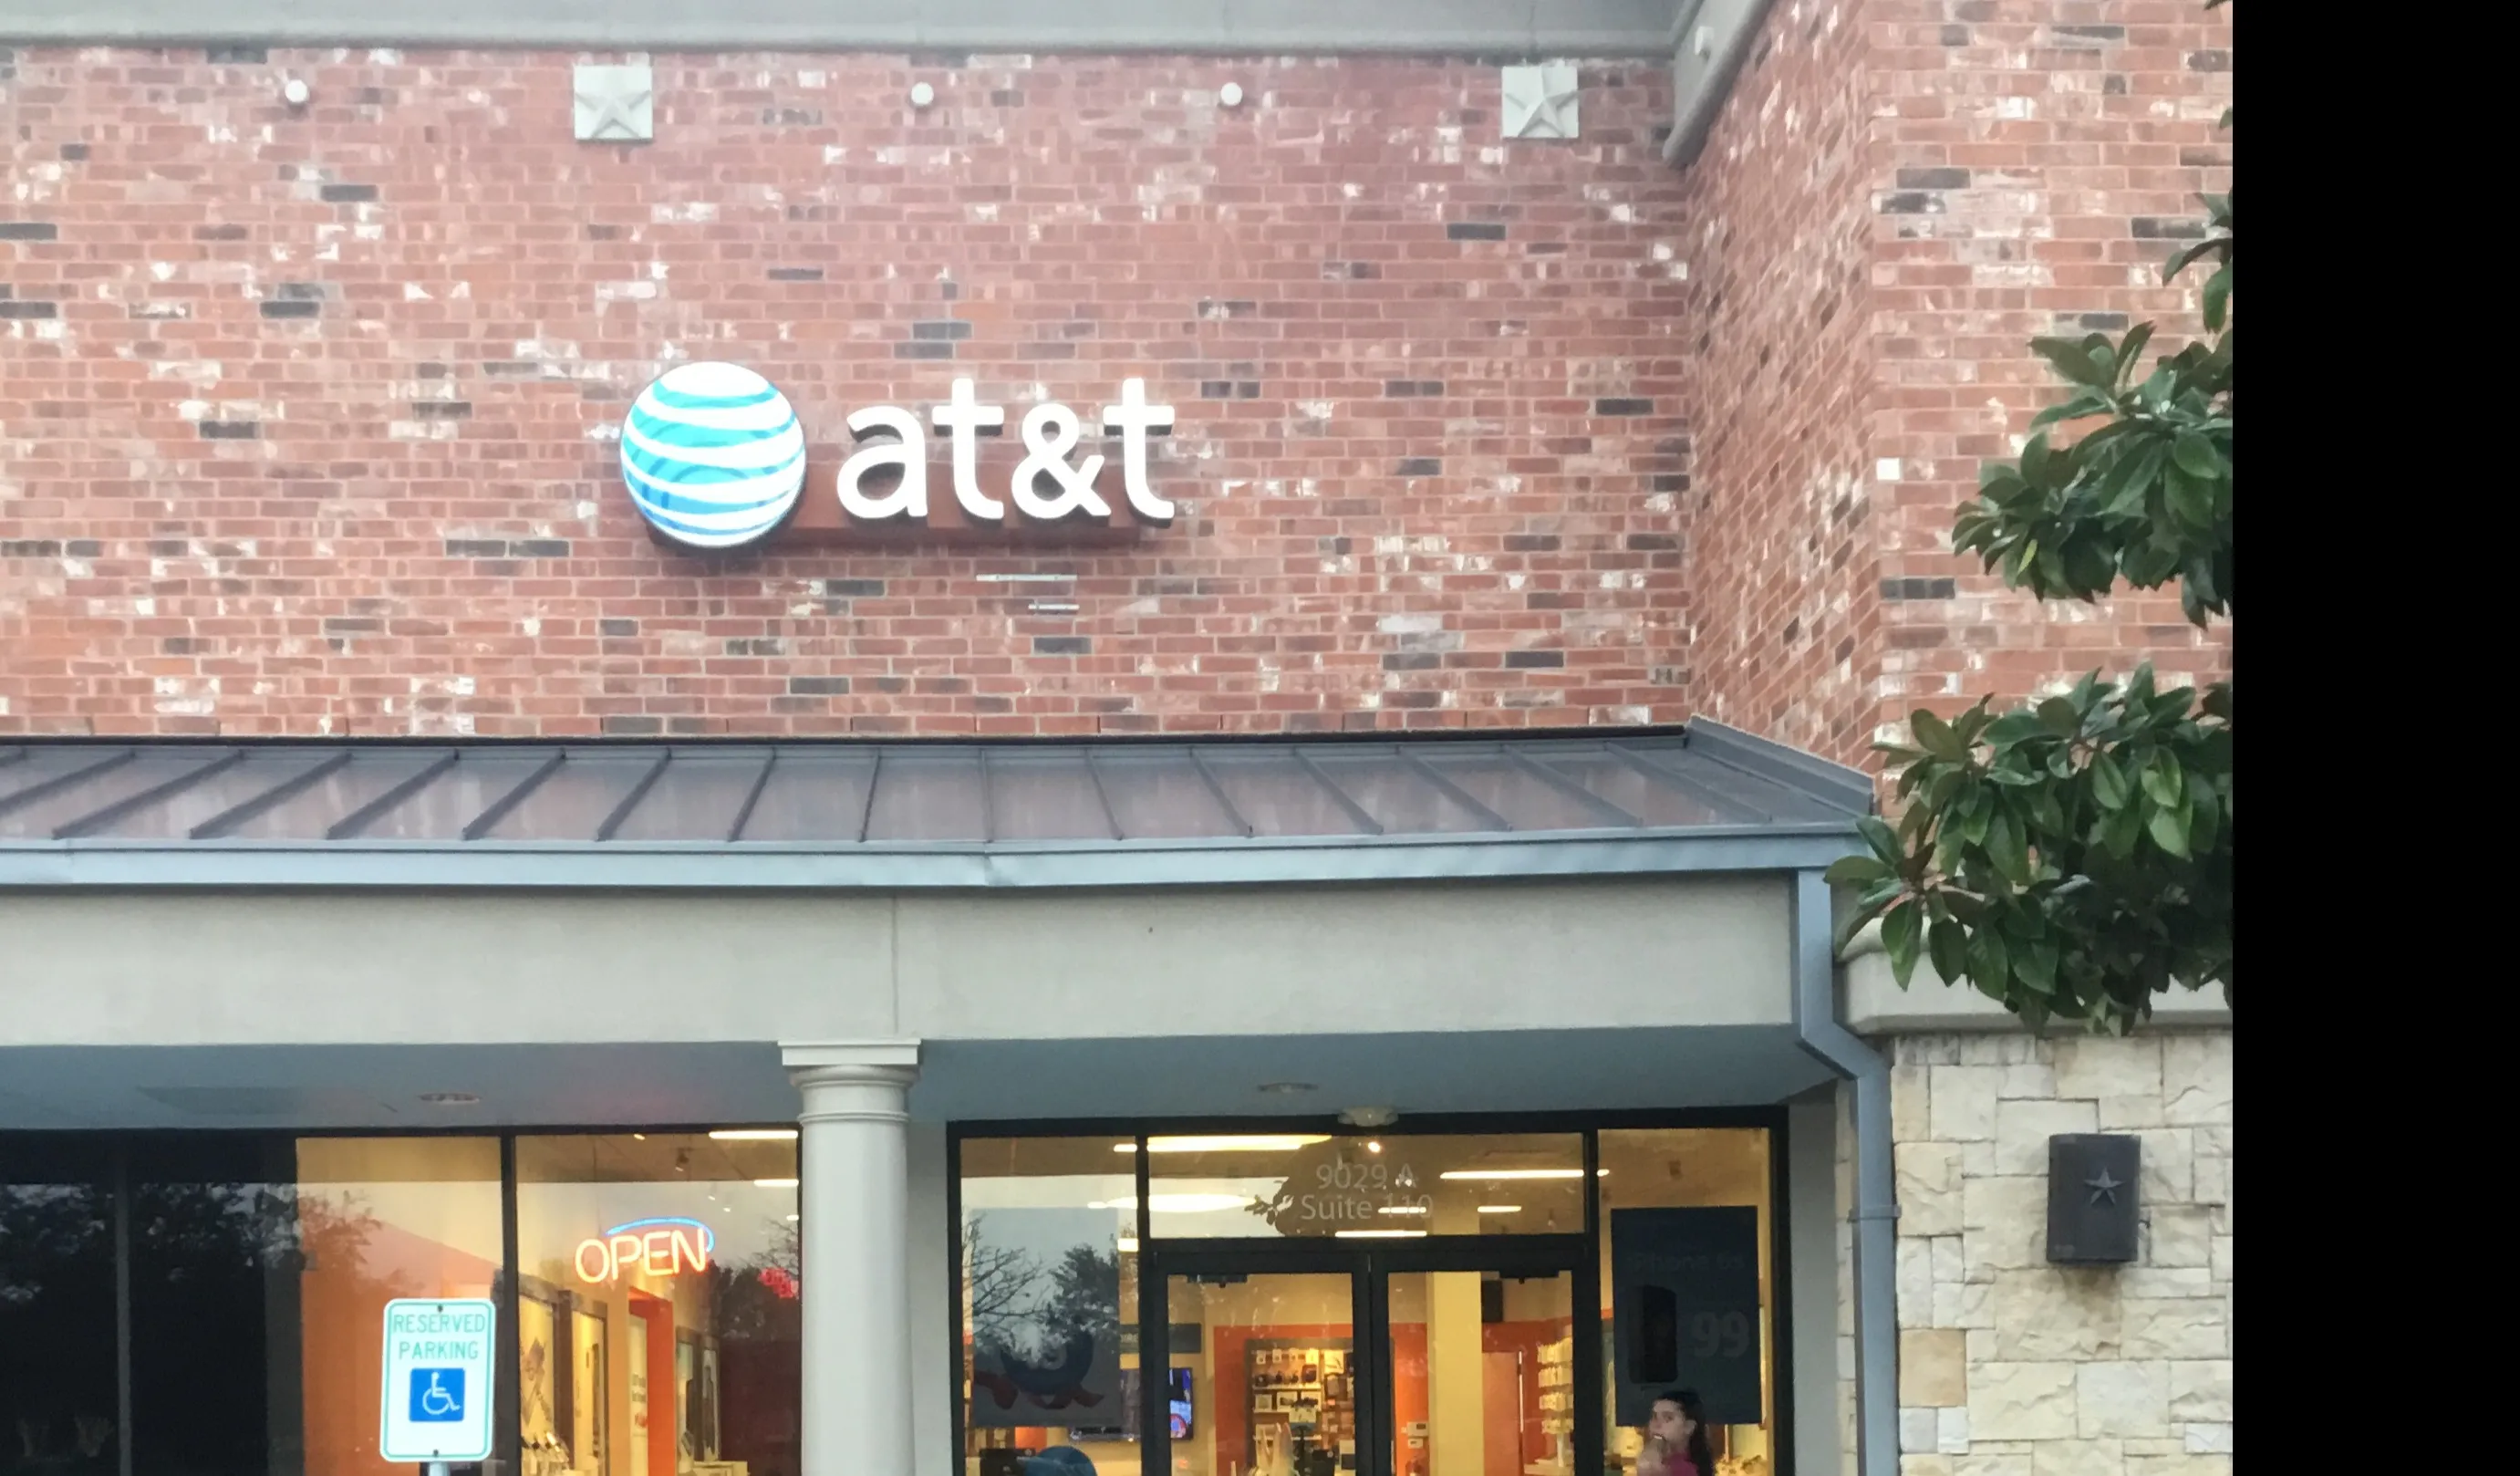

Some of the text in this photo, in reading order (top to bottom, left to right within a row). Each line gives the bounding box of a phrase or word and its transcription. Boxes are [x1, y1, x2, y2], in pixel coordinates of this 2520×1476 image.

[835, 377, 1177, 523] at&t
[1315, 1163, 1419, 1190] 9029 A
[1300, 1193, 1435, 1221] Suite 110
[575, 1228, 707, 1284] OPEN
[392, 1313, 486, 1334] RESERVED
[1691, 1310, 1751, 1358] 99
[398, 1340, 480, 1360] PARKING
